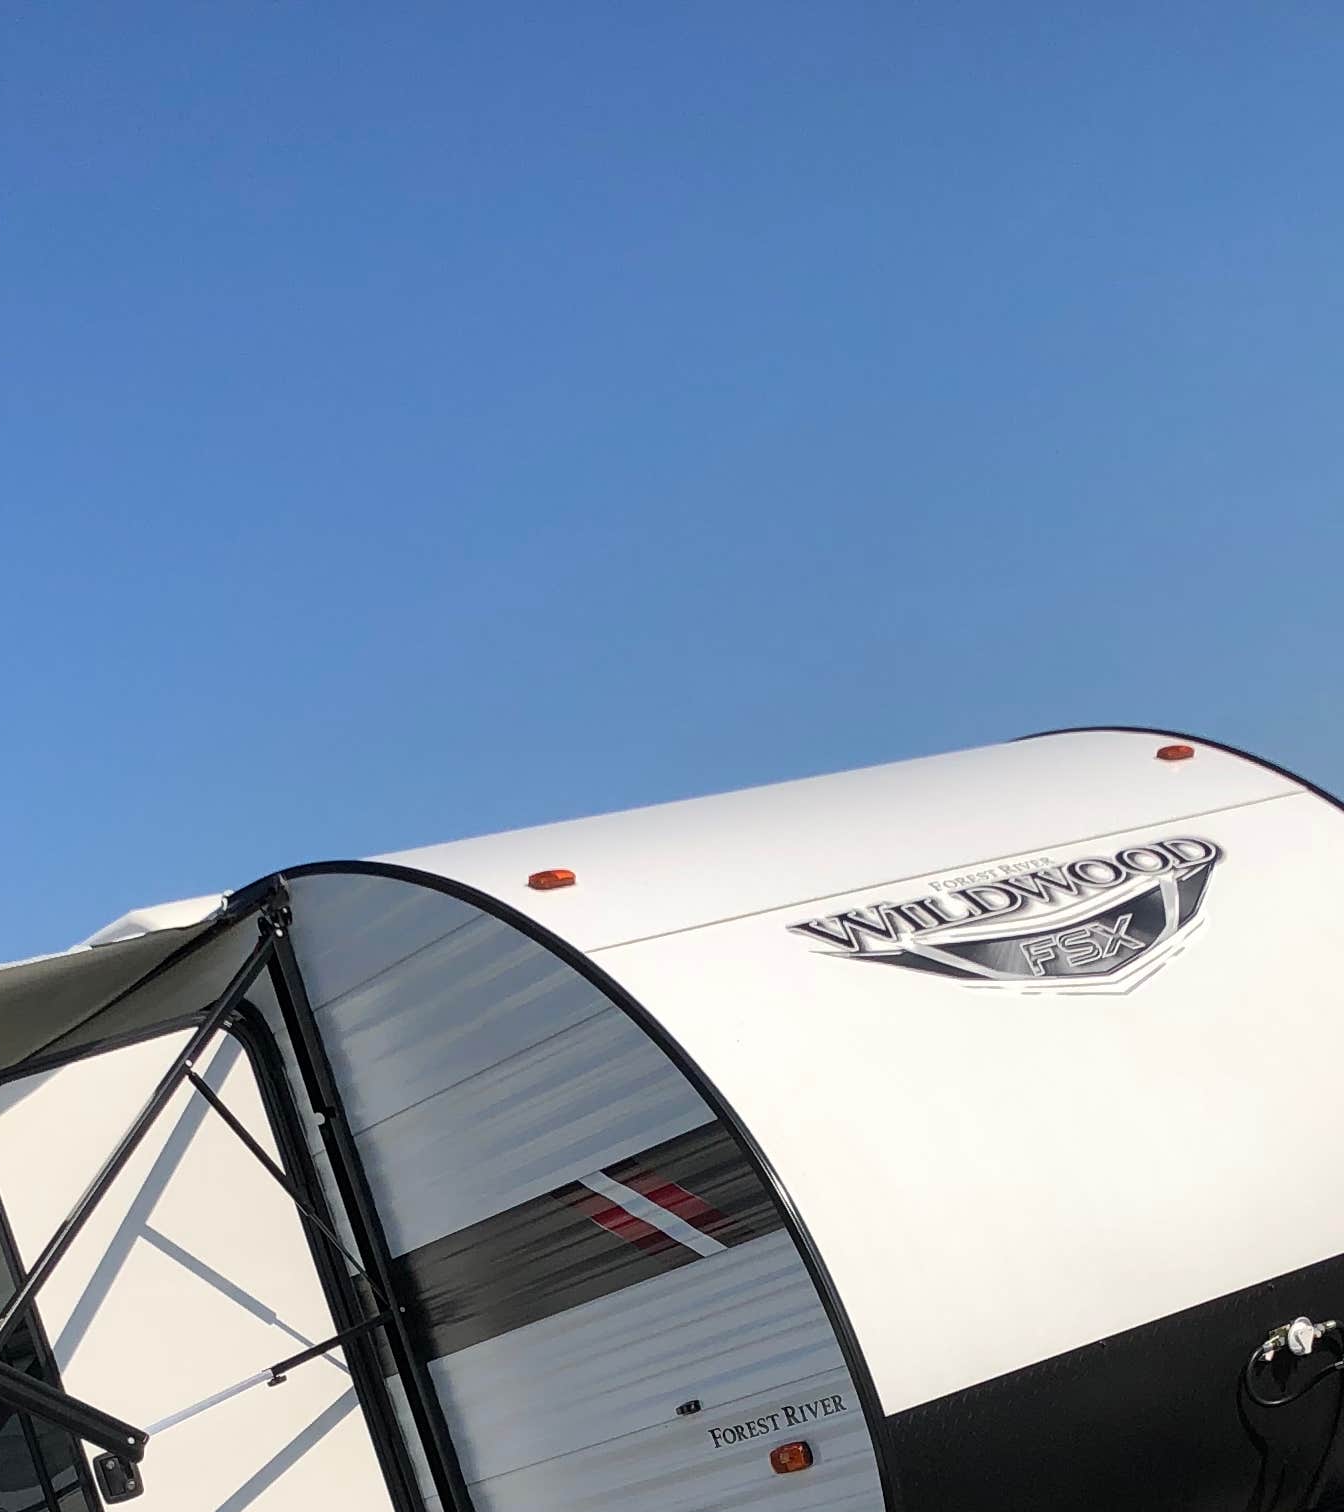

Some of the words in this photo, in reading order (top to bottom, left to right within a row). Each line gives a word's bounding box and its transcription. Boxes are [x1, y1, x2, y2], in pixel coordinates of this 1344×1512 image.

[786, 837, 1222, 952] WILDWOOD
[1021, 912, 1146, 977] FSX
[707, 1412, 781, 1449] FOREST
[781, 1393, 847, 1427] RIVER
